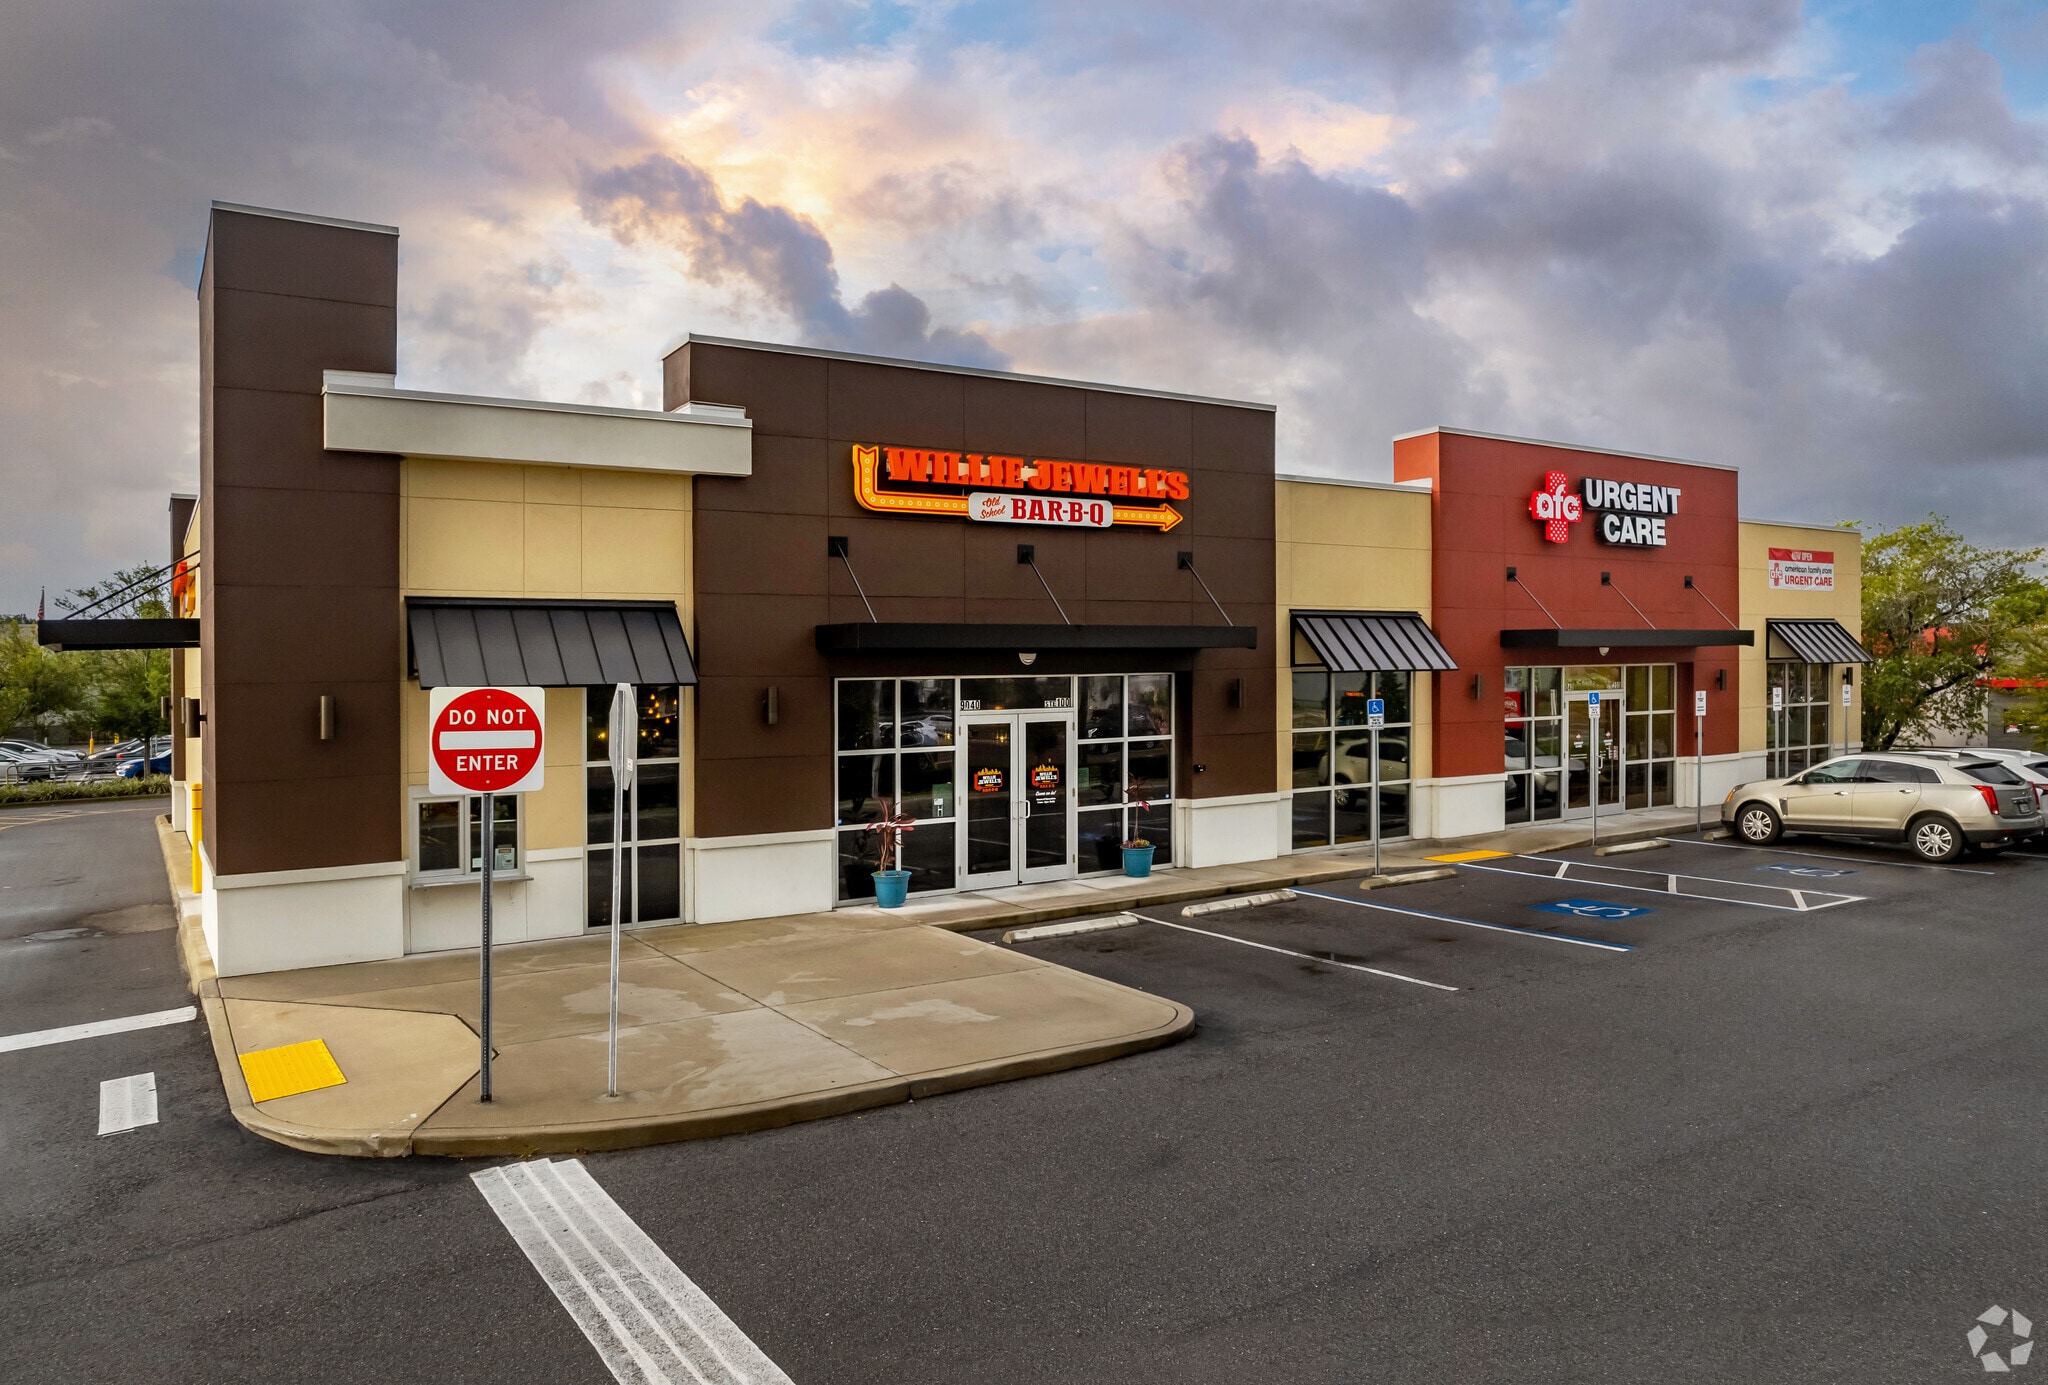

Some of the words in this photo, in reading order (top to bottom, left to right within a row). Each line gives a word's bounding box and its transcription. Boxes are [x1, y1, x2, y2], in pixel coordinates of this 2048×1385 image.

[883, 447, 1024, 488] WILLIE
[1028, 459, 1189, 500] JEWELL'S
[982, 496, 1001, 508] Old
[1536, 484, 1580, 520] afc
[1585, 478, 1681, 514] URGENT
[980, 504, 1007, 520] School
[1011, 498, 1104, 526] BAR-B-Q
[1603, 515, 1666, 545] CARE
[1770, 567, 1782, 579] afc
[1808, 566, 1821, 575] family
[1785, 575, 1813, 585] URGENT
[1814, 576, 1832, 586] CARE
[960, 700, 980, 710] 9040
[449, 709, 476, 725] DO
[487, 709, 527, 725] NOT
[456, 754, 518, 771] ENTER
